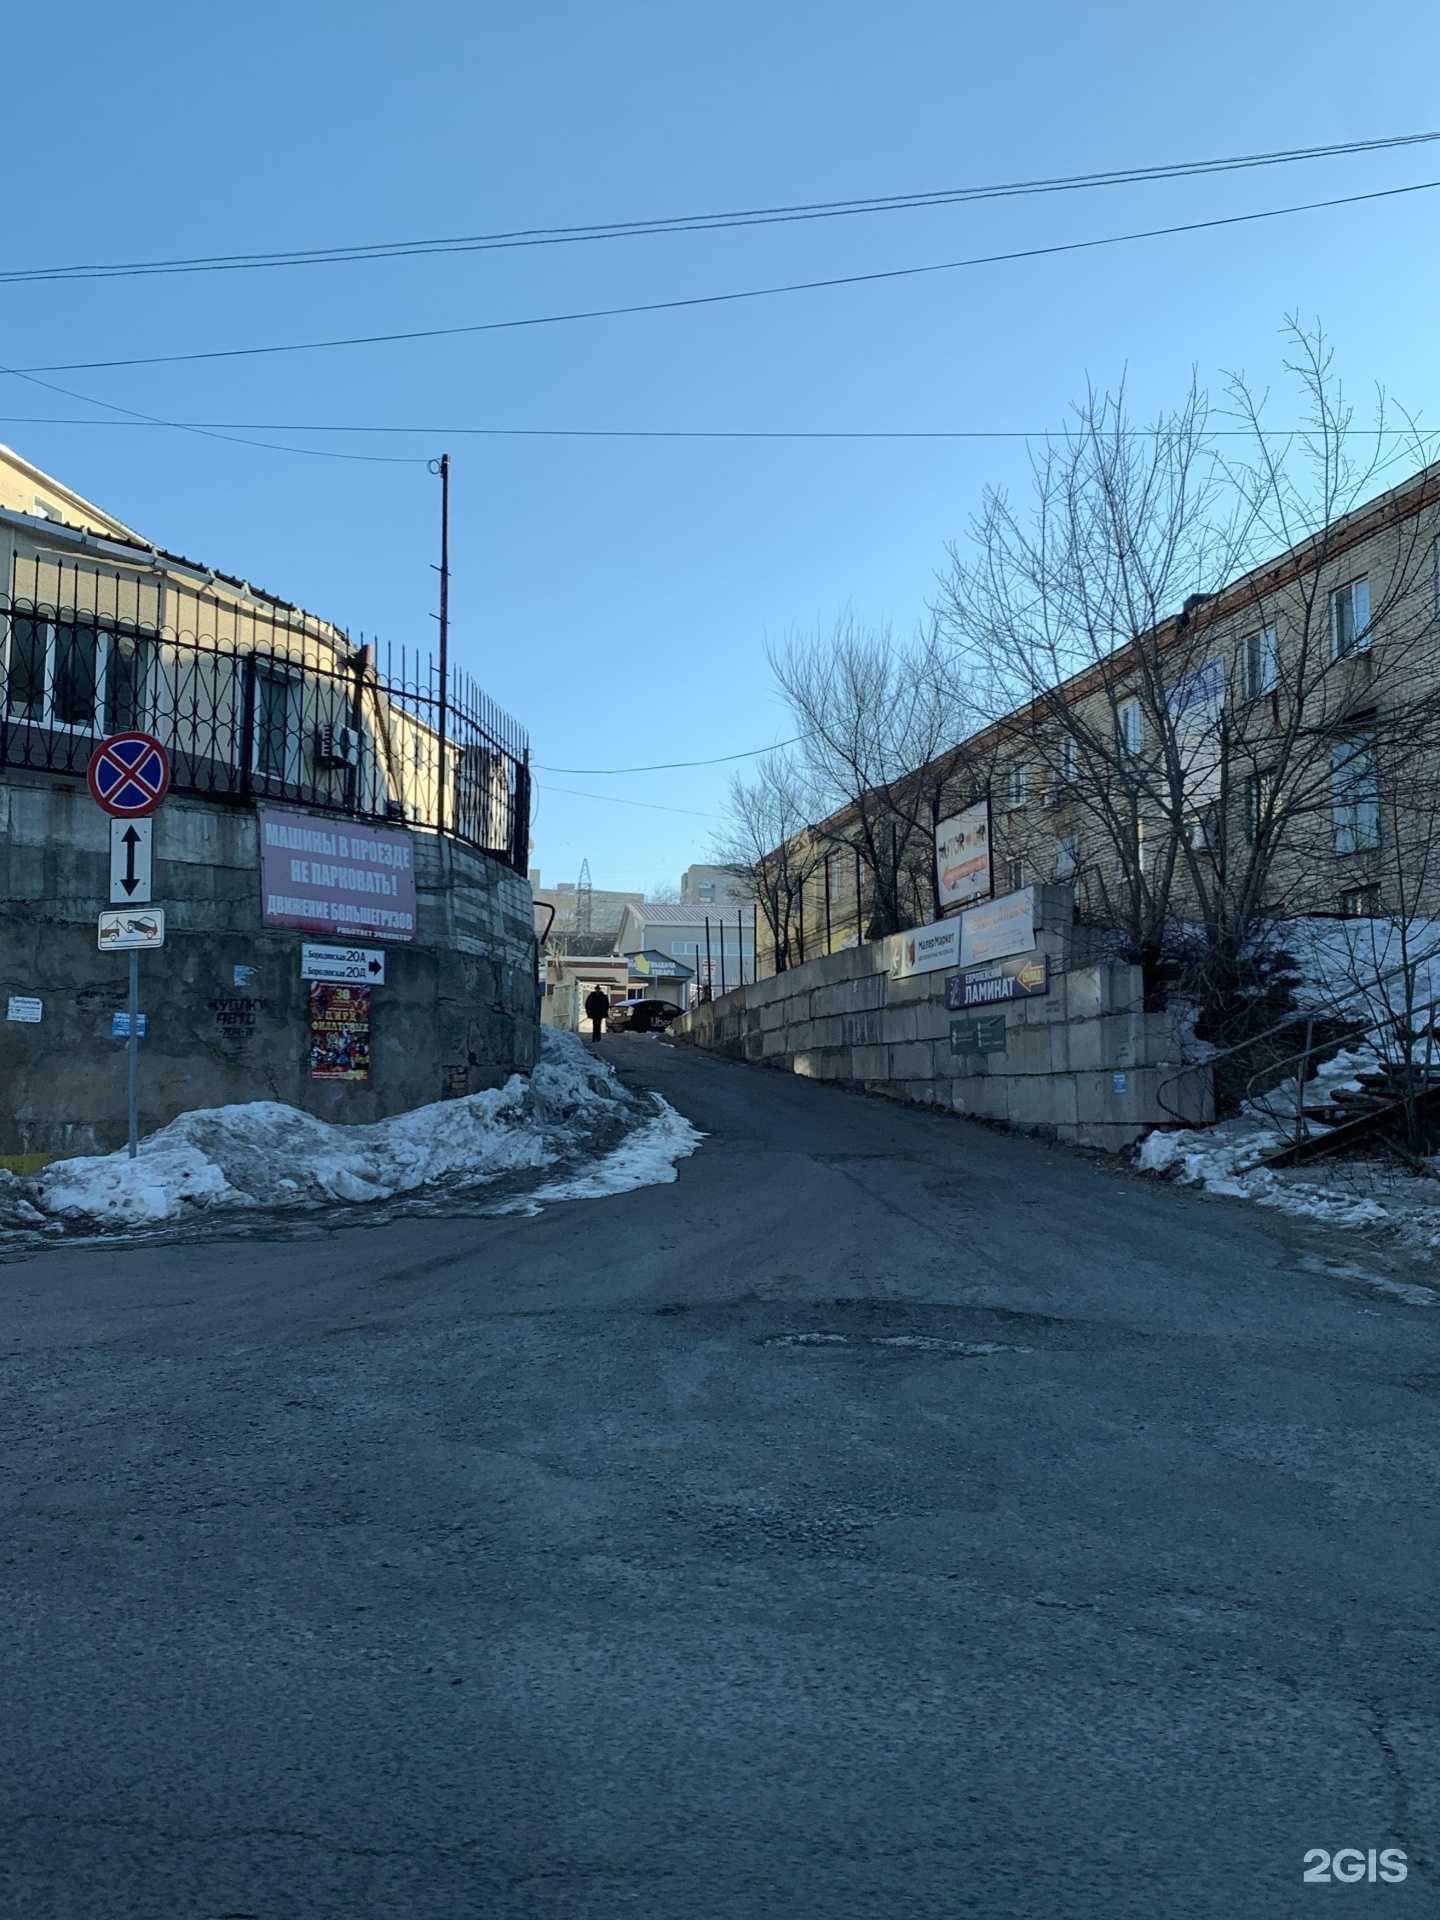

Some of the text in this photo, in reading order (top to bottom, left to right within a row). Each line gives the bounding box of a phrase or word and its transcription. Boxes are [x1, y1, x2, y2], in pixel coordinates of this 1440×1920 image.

[266, 823, 410, 870] МАШИНЫ В ПРОЕЗДЕ
[291, 860, 309, 883] НЕ
[267, 895, 413, 930] ДВИЖЕНИЕ БОЛЬШЕГРУЗОВ
[964, 976, 1015, 1004] ЛАМИНАТ
[216, 1012, 257, 1025] АВТО
[325, 1010, 357, 1022] ЦИРК
